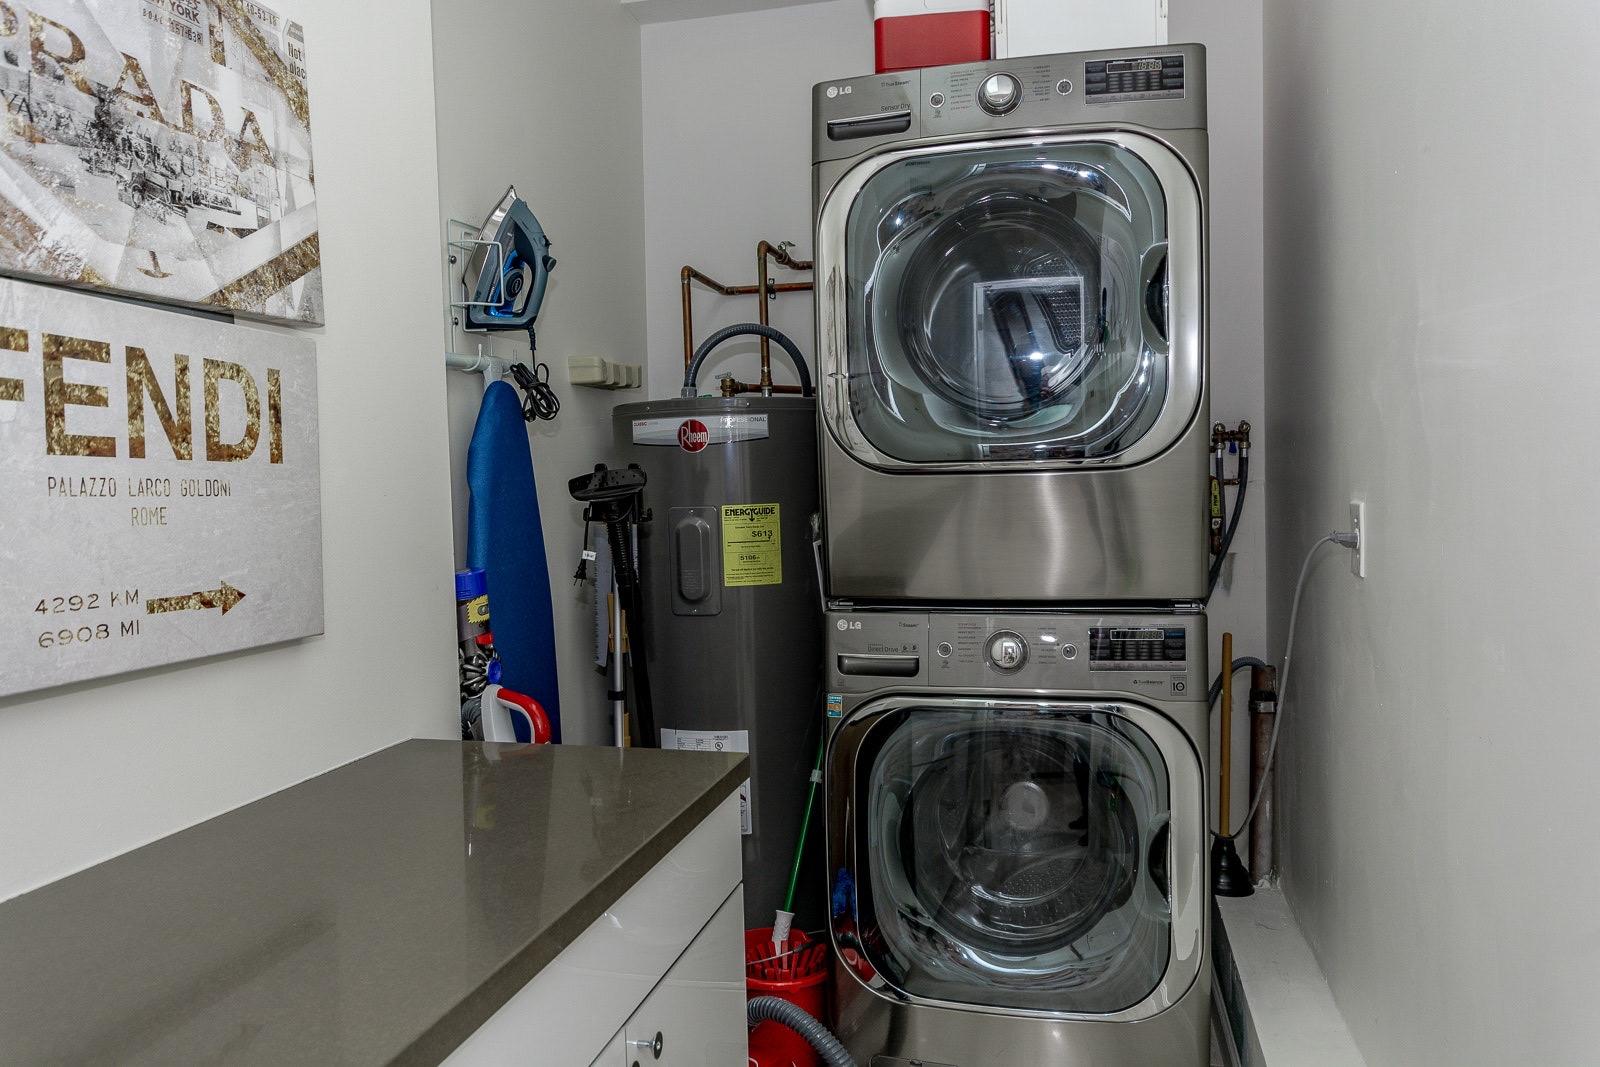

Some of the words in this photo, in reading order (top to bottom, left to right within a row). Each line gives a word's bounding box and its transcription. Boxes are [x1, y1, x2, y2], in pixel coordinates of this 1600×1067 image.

[169, 0, 200, 24] YORK
[839, 85, 852, 95] LG
[880, 104, 900, 112] Sensor
[900, 102, 911, 110] Dry
[680, 420, 708, 448] Rheem
[48, 476, 117, 497] PALAZZO
[180, 479, 231, 497] GOLDONI
[131, 506, 168, 526] ROME
[724, 506, 776, 517] ENERGYGUIDE
[34, 592, 100, 616] 4292
[110, 588, 139, 608] KM
[38, 623, 110, 649] 6908
[120, 619, 140, 637] MI
[849, 621, 862, 630] LG
